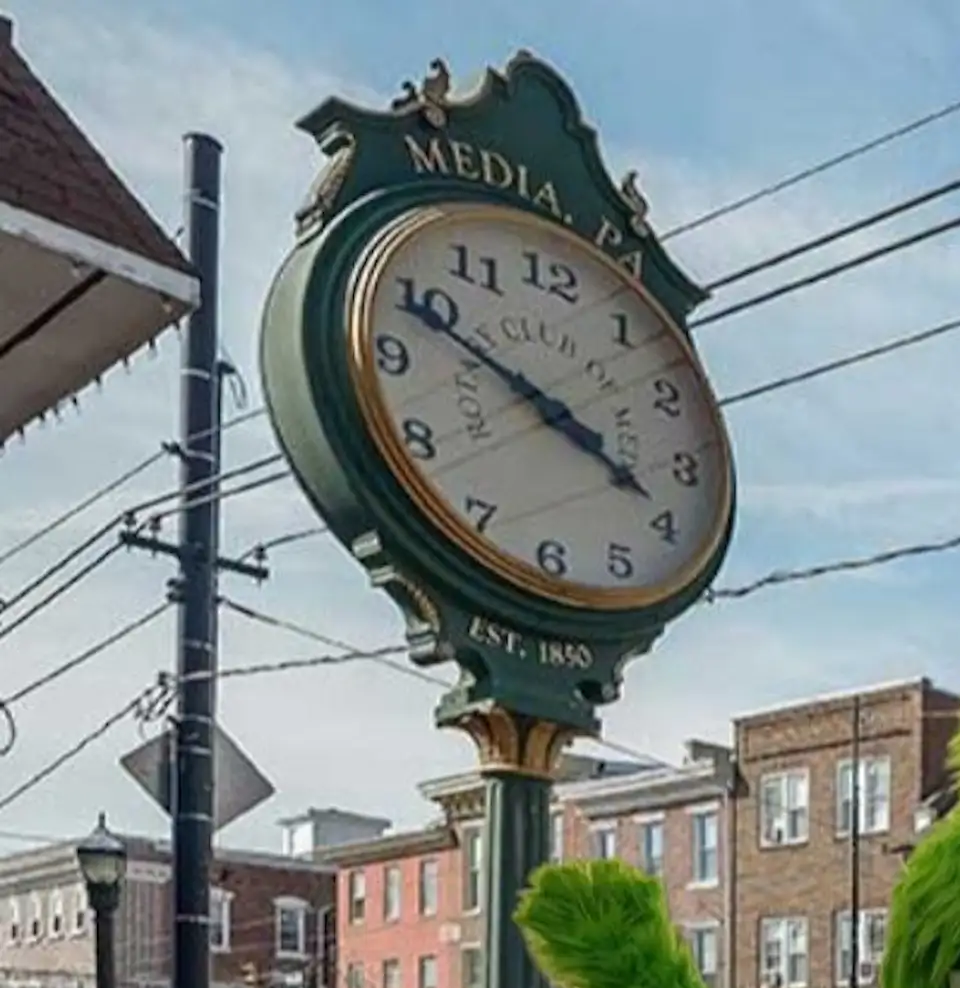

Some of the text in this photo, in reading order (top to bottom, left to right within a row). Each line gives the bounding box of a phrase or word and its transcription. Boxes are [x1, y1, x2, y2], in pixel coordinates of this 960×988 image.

[595, 214, 644, 282] PA
[449, 244, 504, 298] 11
[522, 251, 579, 303] 12
[395, 276, 459, 331] 10
[609, 311, 637, 349] 1
[376, 333, 409, 376] 9
[653, 376, 681, 418] 2
[403, 417, 437, 460] 8
[672, 451, 699, 487] 3
[465, 495, 498, 533] 7
[649, 509, 680, 544] 4
[536, 538, 567, 577] 6
[607, 541, 633, 579] 5
[468, 616, 527, 660] EST.
